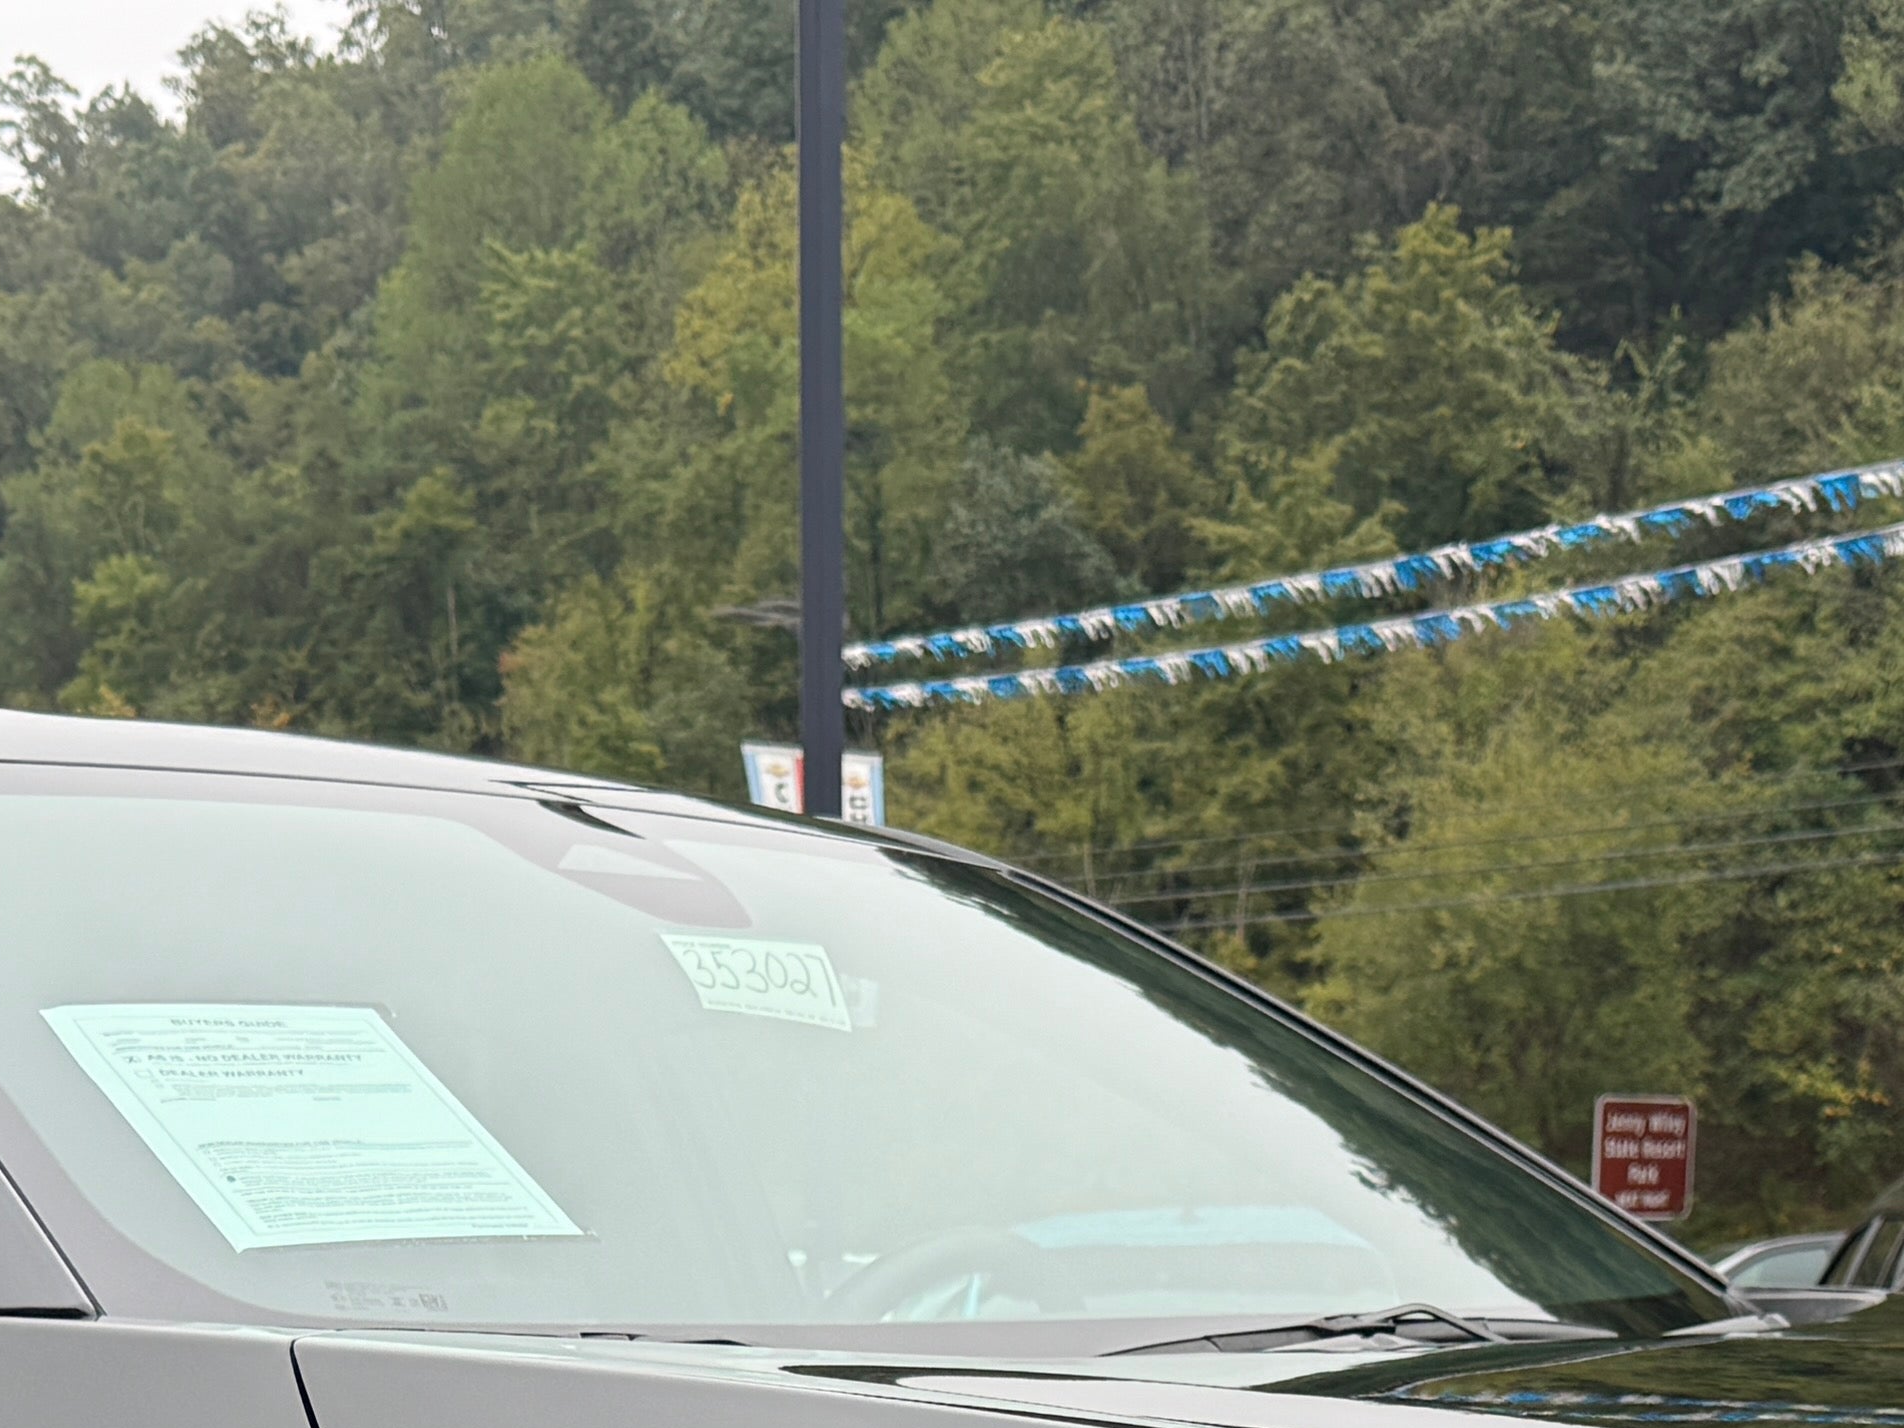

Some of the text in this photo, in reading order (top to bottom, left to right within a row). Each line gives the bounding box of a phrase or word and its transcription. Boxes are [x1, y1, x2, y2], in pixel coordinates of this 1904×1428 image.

[682, 948, 838, 1008] 353027
[222, 1054, 279, 1064] DEALER
[282, 1053, 363, 1063] WARRANTY
[159, 1069, 304, 1078] DEALER WARRANTY
